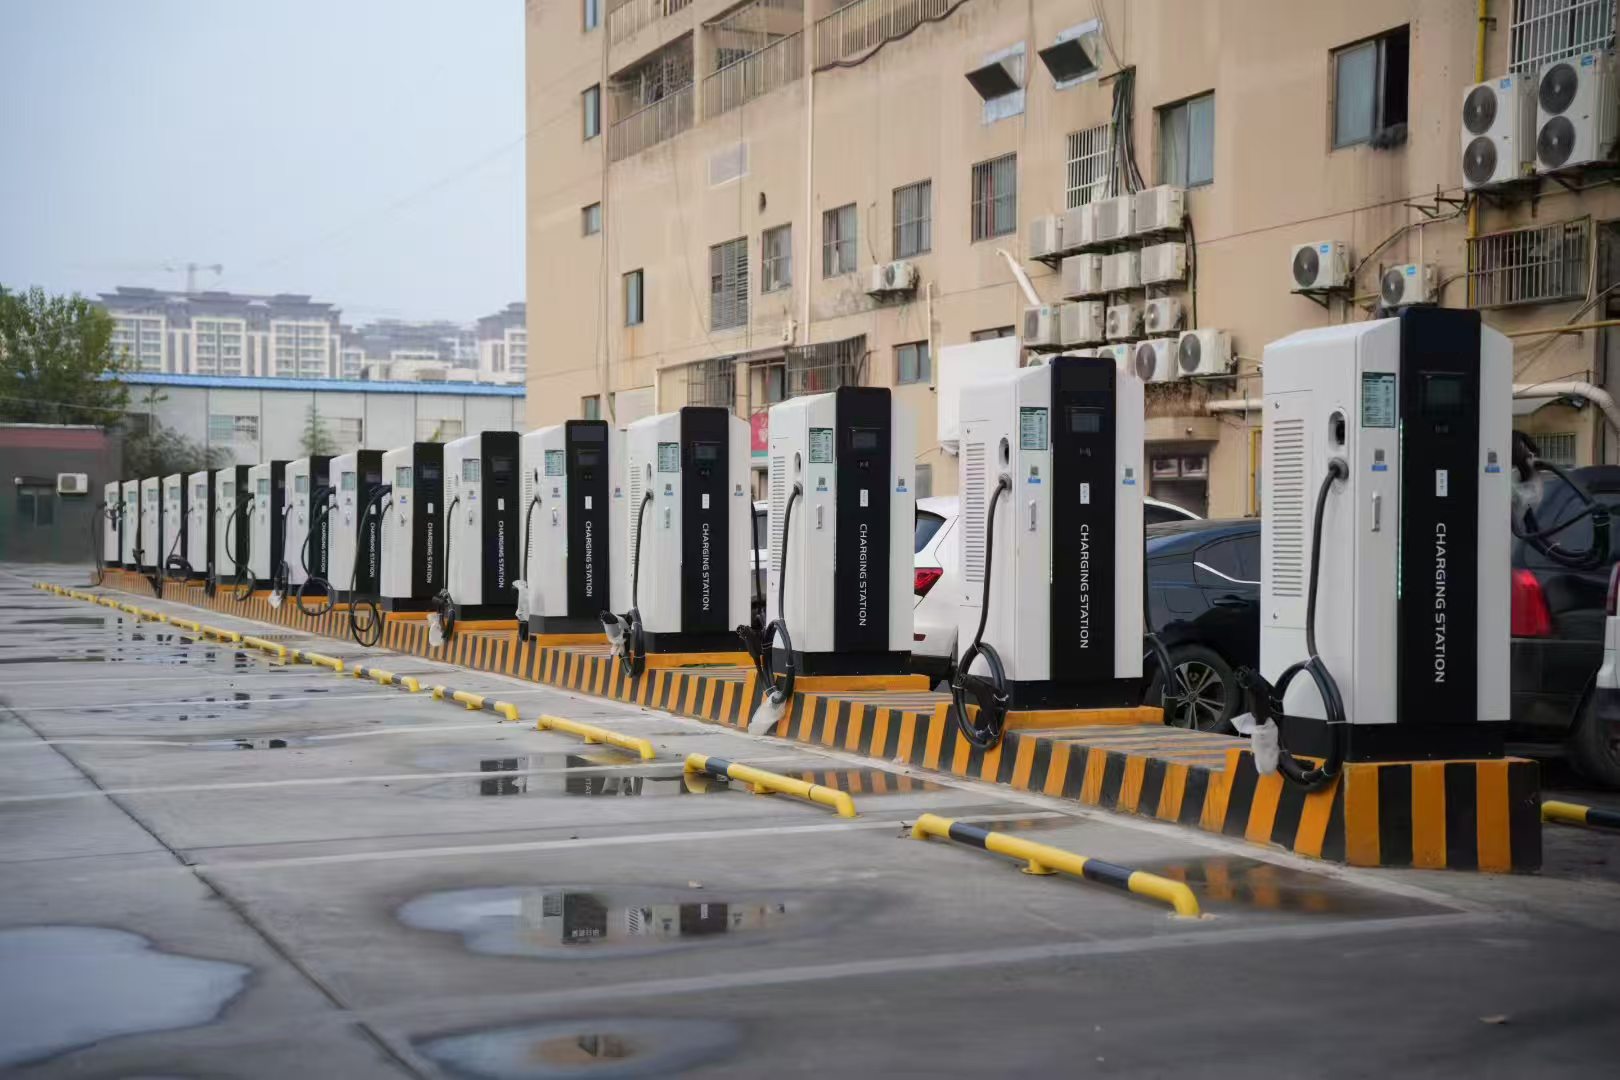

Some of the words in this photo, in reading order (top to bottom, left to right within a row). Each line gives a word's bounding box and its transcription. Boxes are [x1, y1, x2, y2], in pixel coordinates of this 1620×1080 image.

[702, 523, 710, 571] CHARGING
[859, 523, 868, 579] CHARGING
[1080, 523, 1090, 592] CHARGING
[1435, 522, 1447, 609] CHARGING
[702, 572, 710, 611] STATION
[859, 581, 867, 626] STATION
[1080, 594, 1089, 649] STATION
[1434, 612, 1446, 683] STATION
